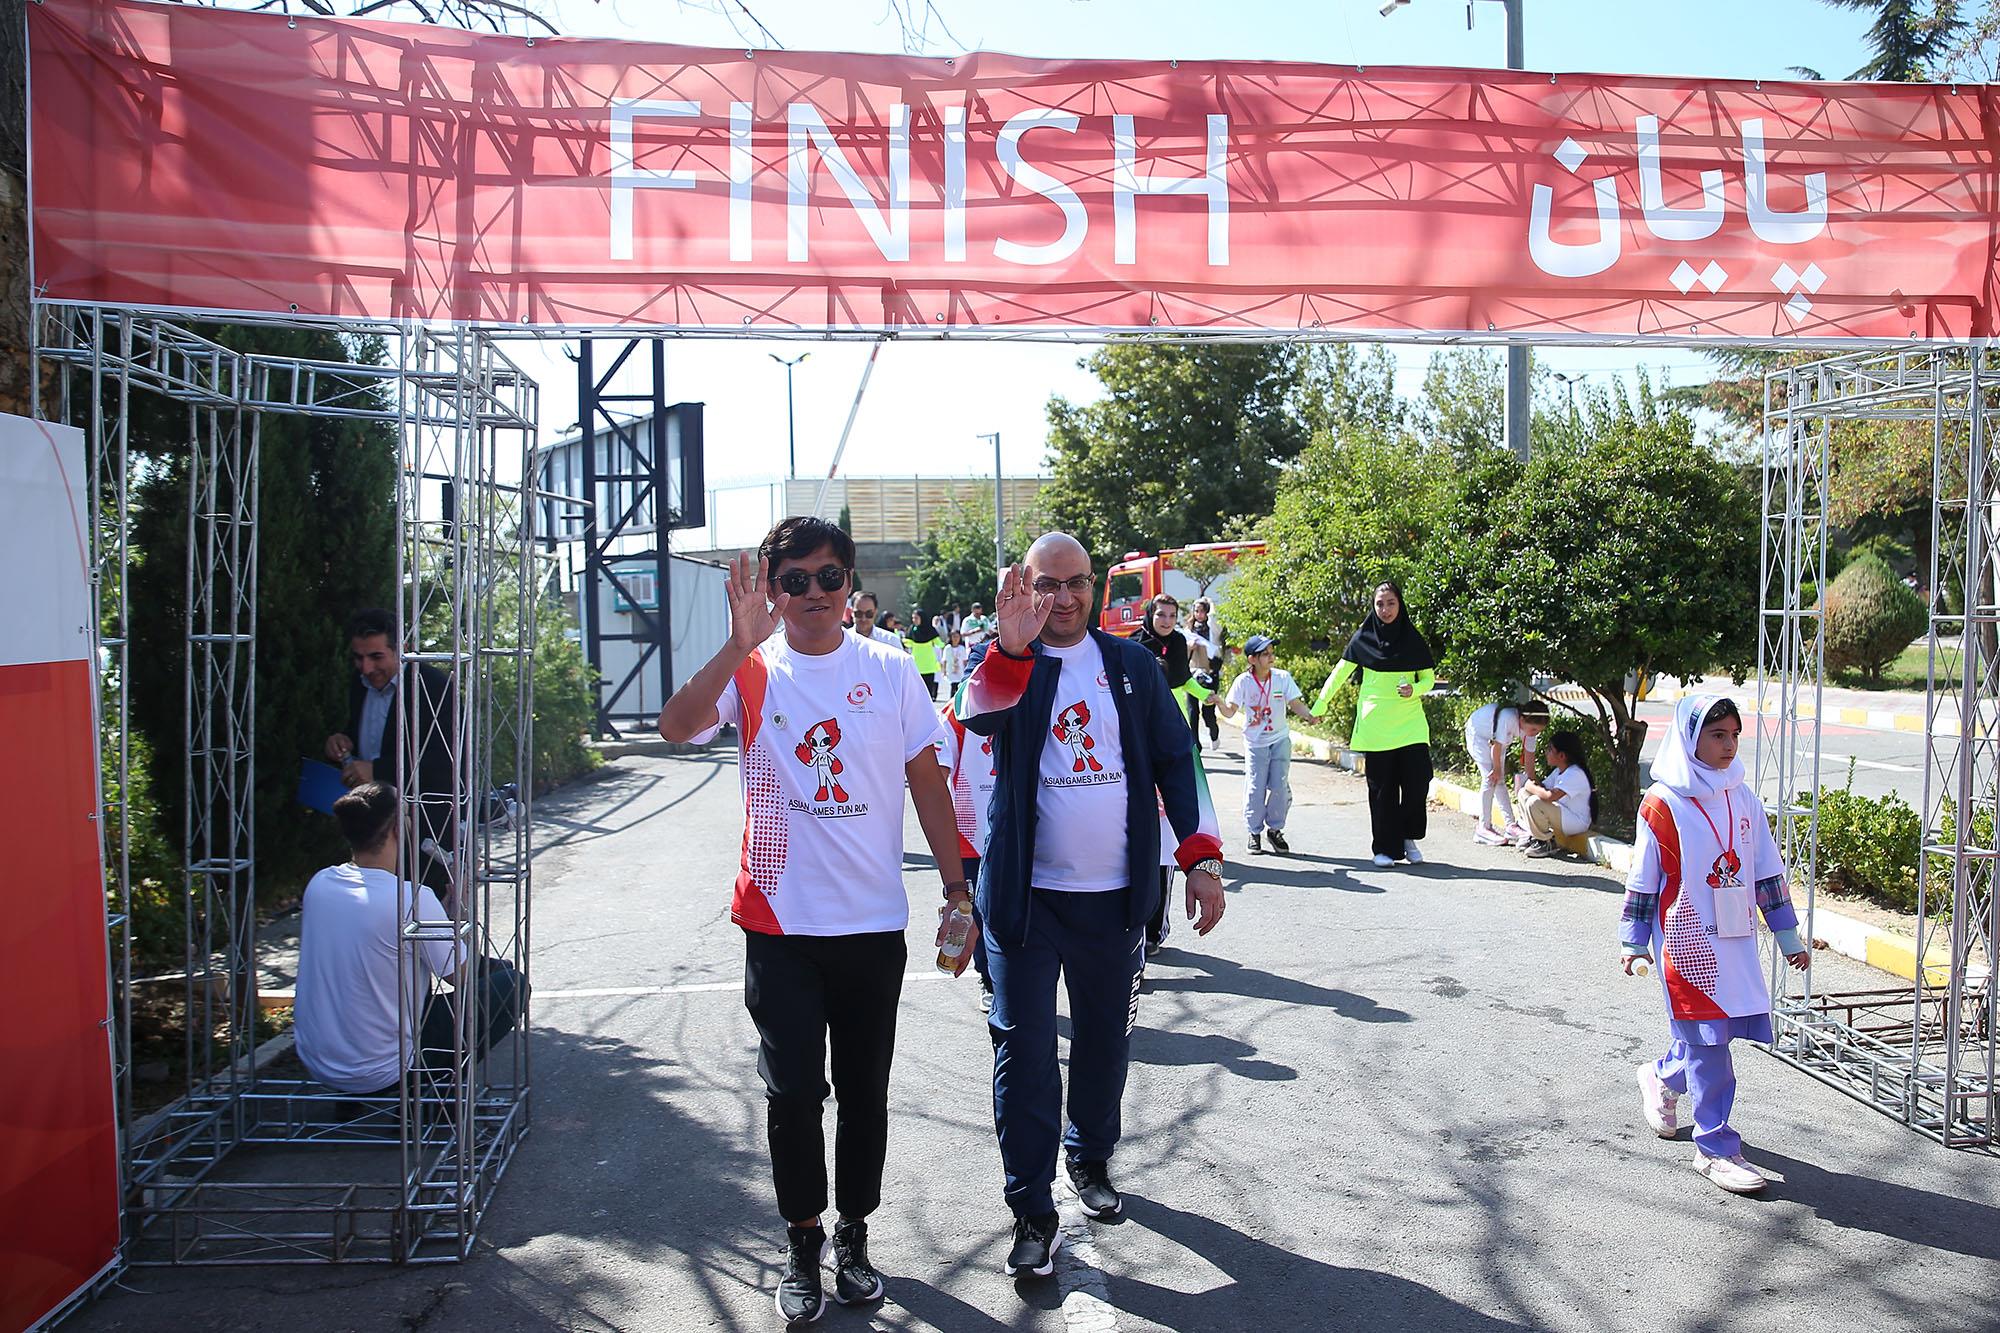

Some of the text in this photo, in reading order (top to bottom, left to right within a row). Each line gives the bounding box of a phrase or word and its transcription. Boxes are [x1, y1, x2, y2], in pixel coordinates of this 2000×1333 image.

[609, 98, 1231, 267] FINISH
[1528, 113, 1829, 324] پایان
[788, 799, 868, 816] ASIAN AMES FUN RUN
[1044, 771, 1122, 786] ASIAN GAMES FUN RUN
